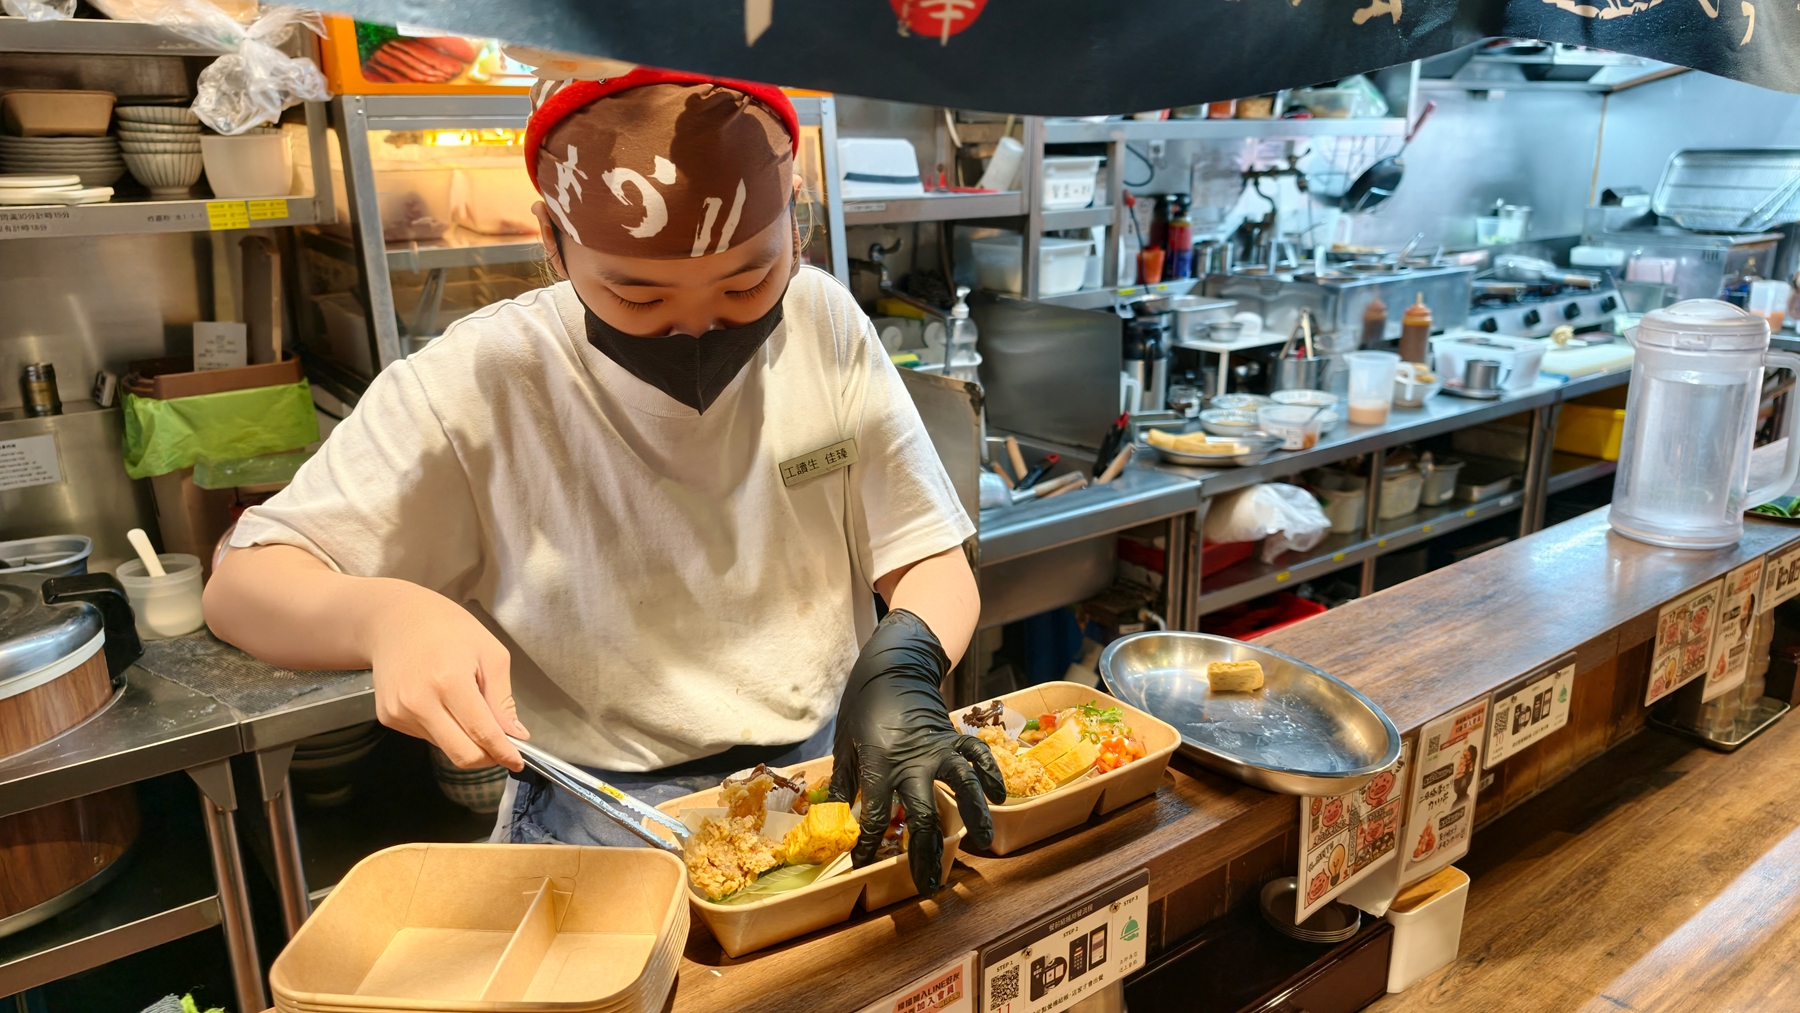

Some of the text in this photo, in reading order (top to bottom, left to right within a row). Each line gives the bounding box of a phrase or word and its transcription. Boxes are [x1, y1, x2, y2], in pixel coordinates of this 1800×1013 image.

[784, 448, 848, 479] 工讀生 佳臻
[1123, 897, 1134, 907] STEP
[1062, 928, 1075, 939] STEP
[996, 961, 1009, 973] STEP
